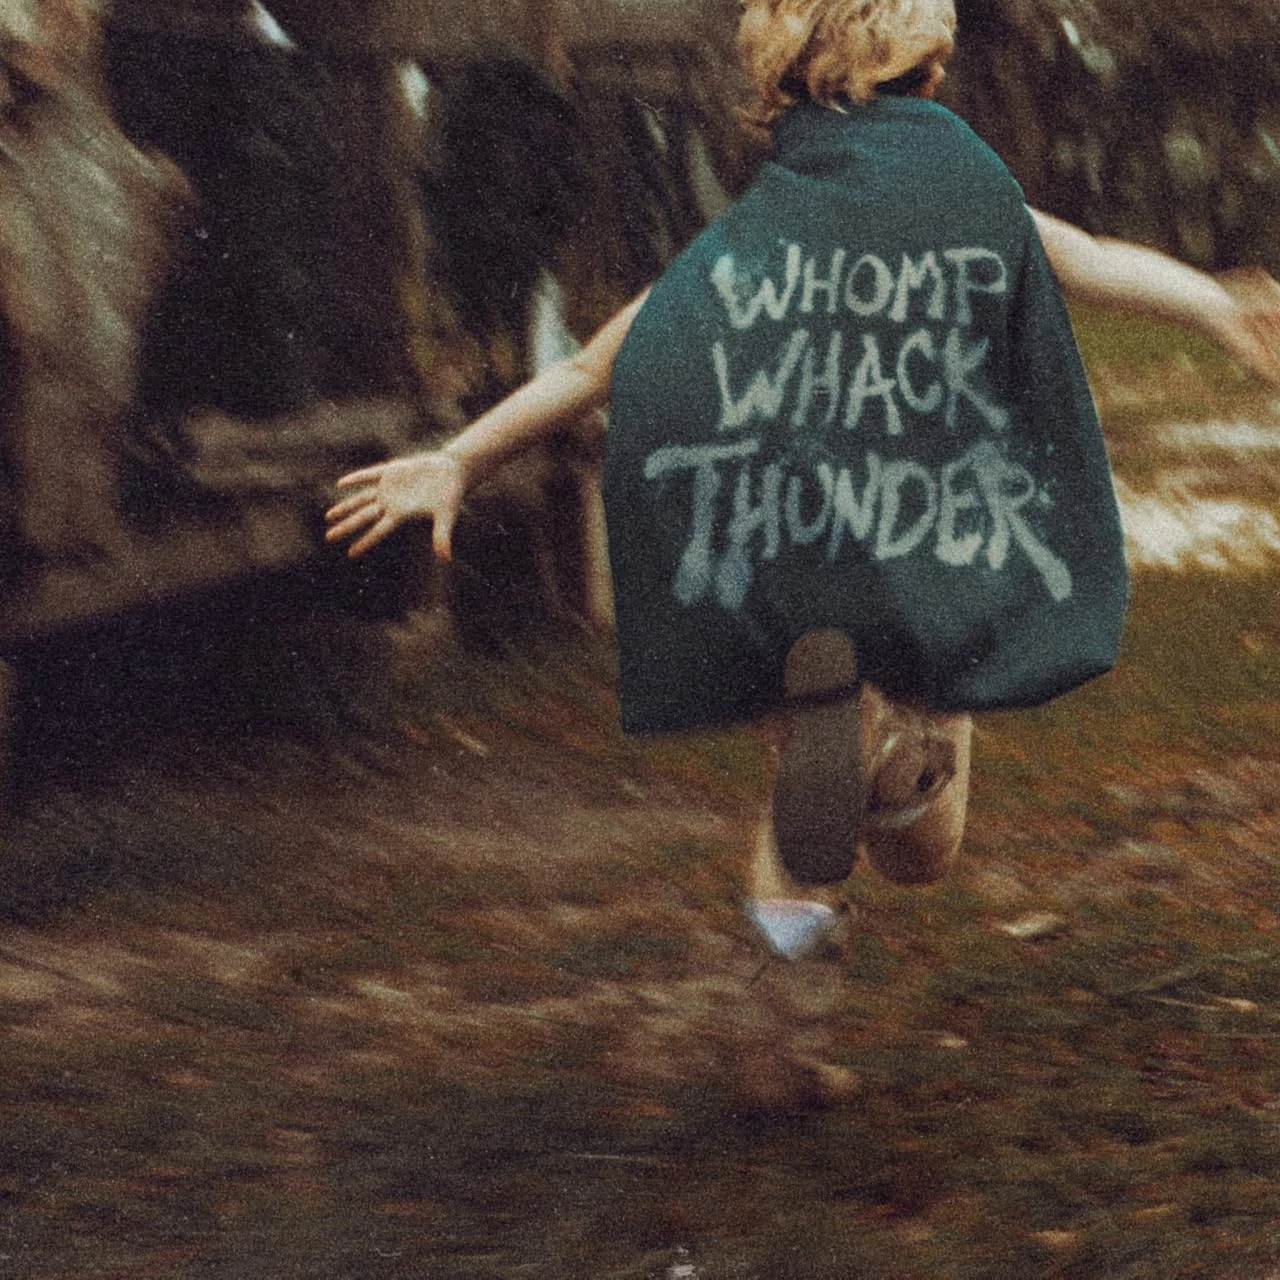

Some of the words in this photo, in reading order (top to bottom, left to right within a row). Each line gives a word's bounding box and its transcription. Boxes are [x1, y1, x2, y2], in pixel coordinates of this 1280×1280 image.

[711, 239, 1007, 329] WHOMP
[712, 328, 1008, 434] WHACK
[644, 440, 1073, 608] THUNDER
